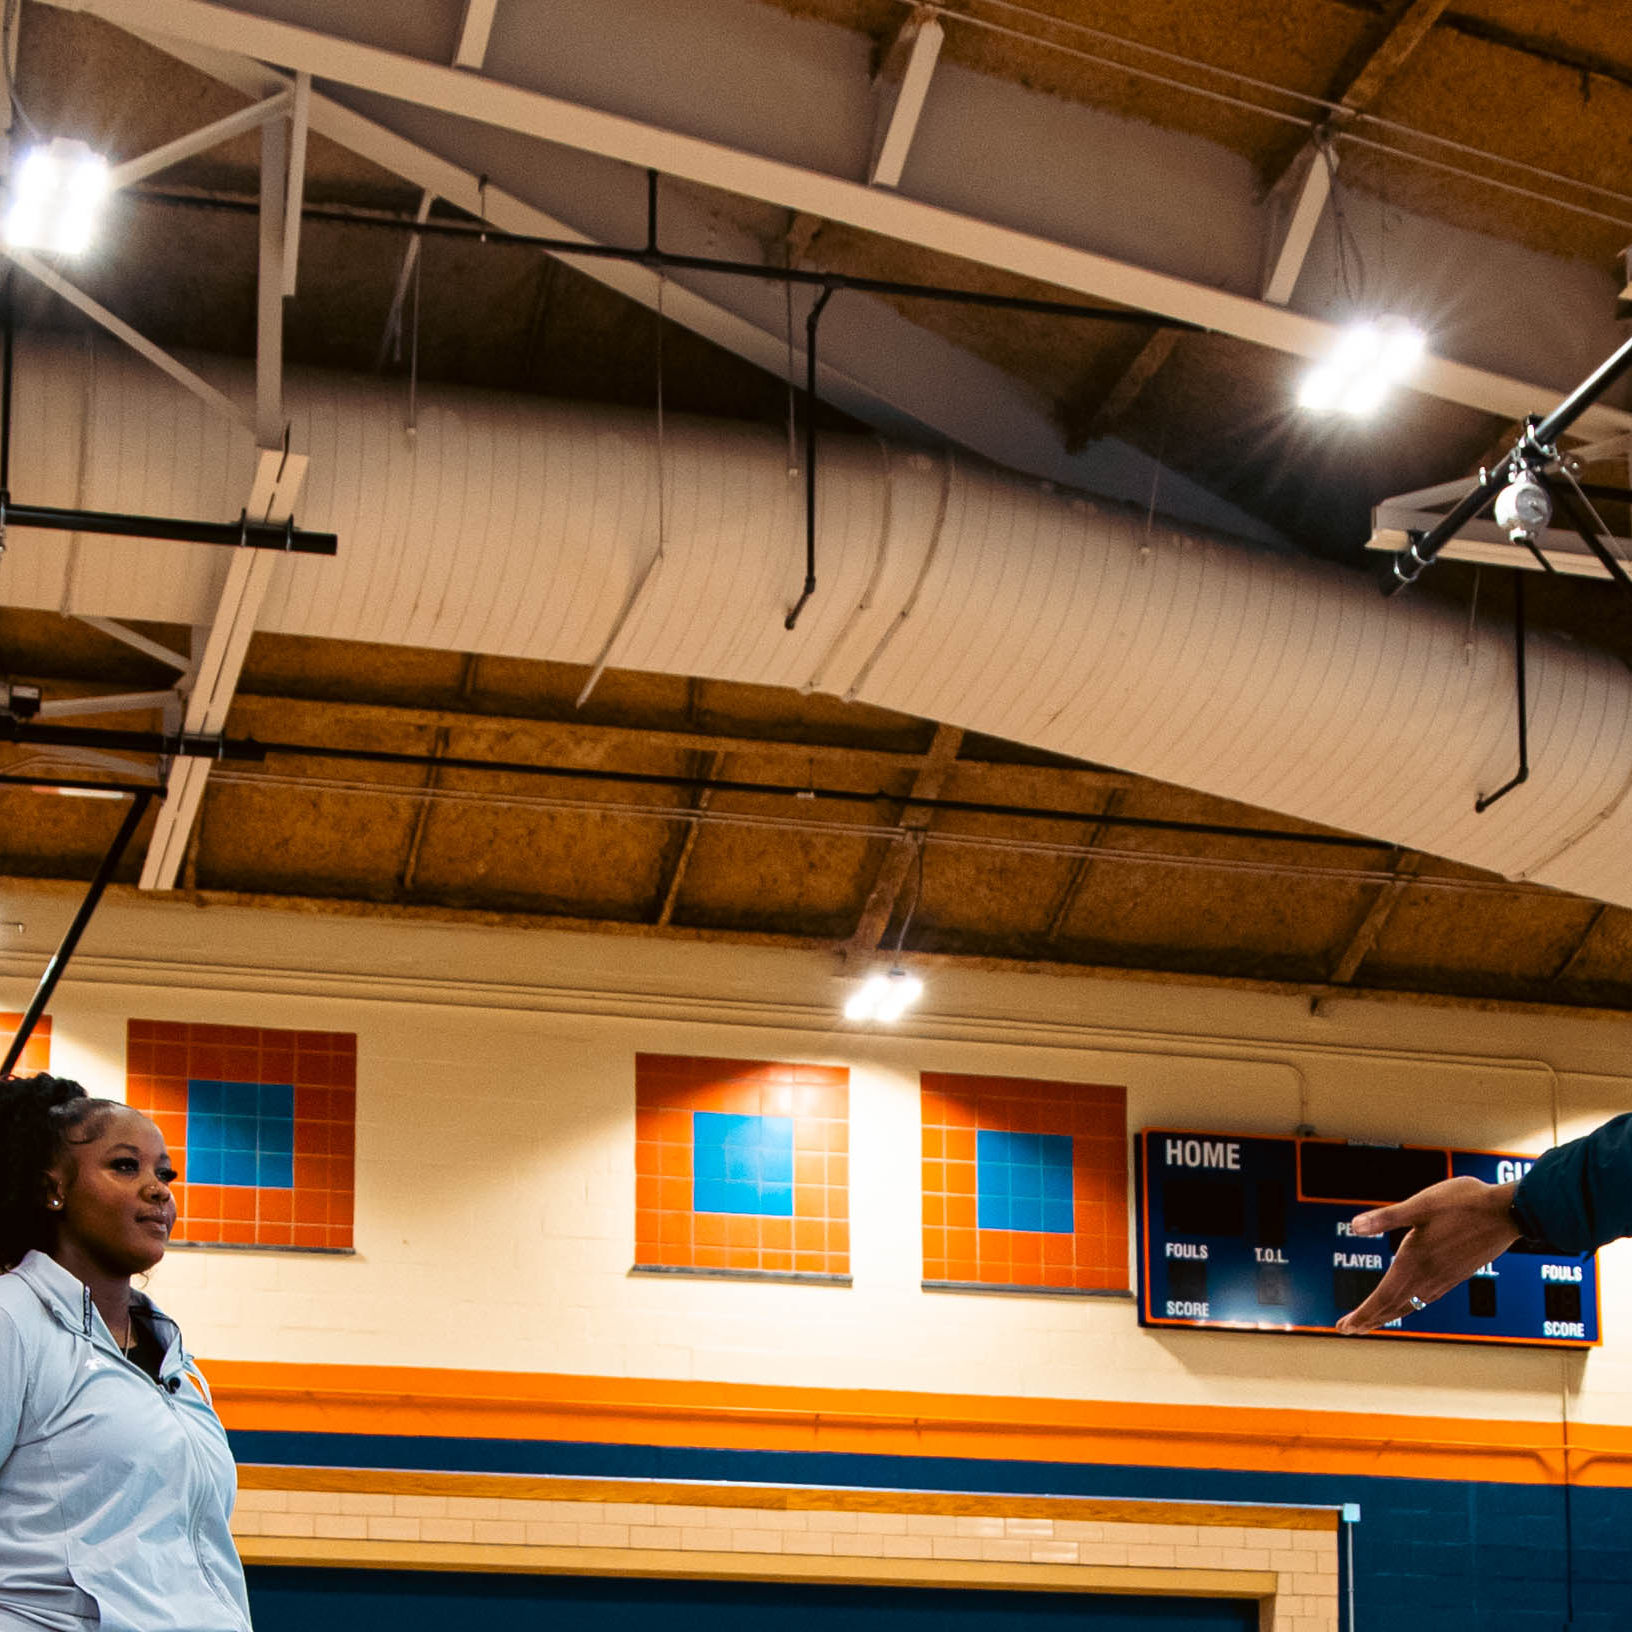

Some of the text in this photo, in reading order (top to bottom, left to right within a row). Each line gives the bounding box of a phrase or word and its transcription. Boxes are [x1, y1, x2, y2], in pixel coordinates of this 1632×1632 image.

[1166, 1139, 1241, 1170] HOME
[1166, 1242, 1208, 1259] FOULS
[1255, 1247, 1289, 1264] T.O.L.
[1334, 1252, 1383, 1270] PLAYER
[1541, 1264, 1582, 1282] FOULS
[1166, 1300, 1209, 1317] SCORE
[1543, 1321, 1584, 1338] SCORE
